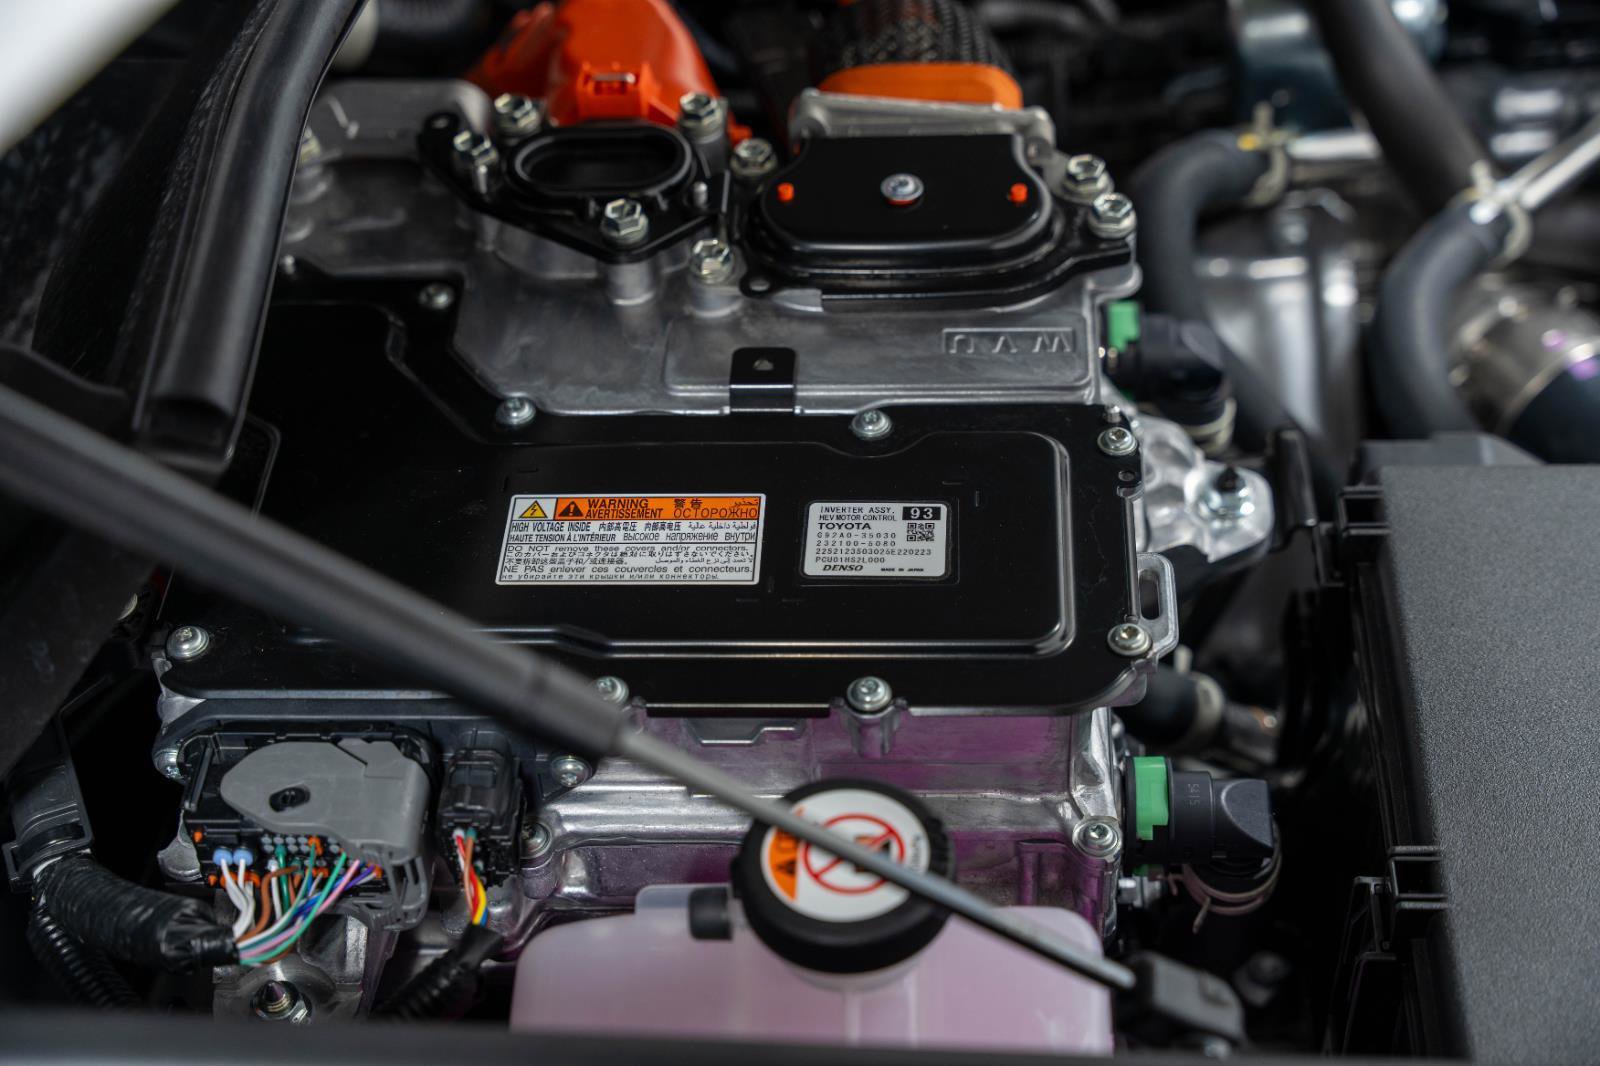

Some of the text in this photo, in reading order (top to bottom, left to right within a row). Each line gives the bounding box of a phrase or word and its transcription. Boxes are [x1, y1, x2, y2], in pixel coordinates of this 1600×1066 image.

[588, 499, 649, 508] WARNING
[585, 508, 663, 519] AVERTISSEMENT
[674, 508, 757, 518] ОСТОРОЖНО
[910, 508, 933, 519] 93
[511, 522, 591, 532] HIGH VOLTAGE INSIDE
[509, 534, 533, 542] HAUTE
[535, 534, 565, 542] TENSION
[573, 532, 616, 541] L'INTÉRIEUR
[666, 533, 718, 541] напряжение
[725, 532, 756, 542] внутри
